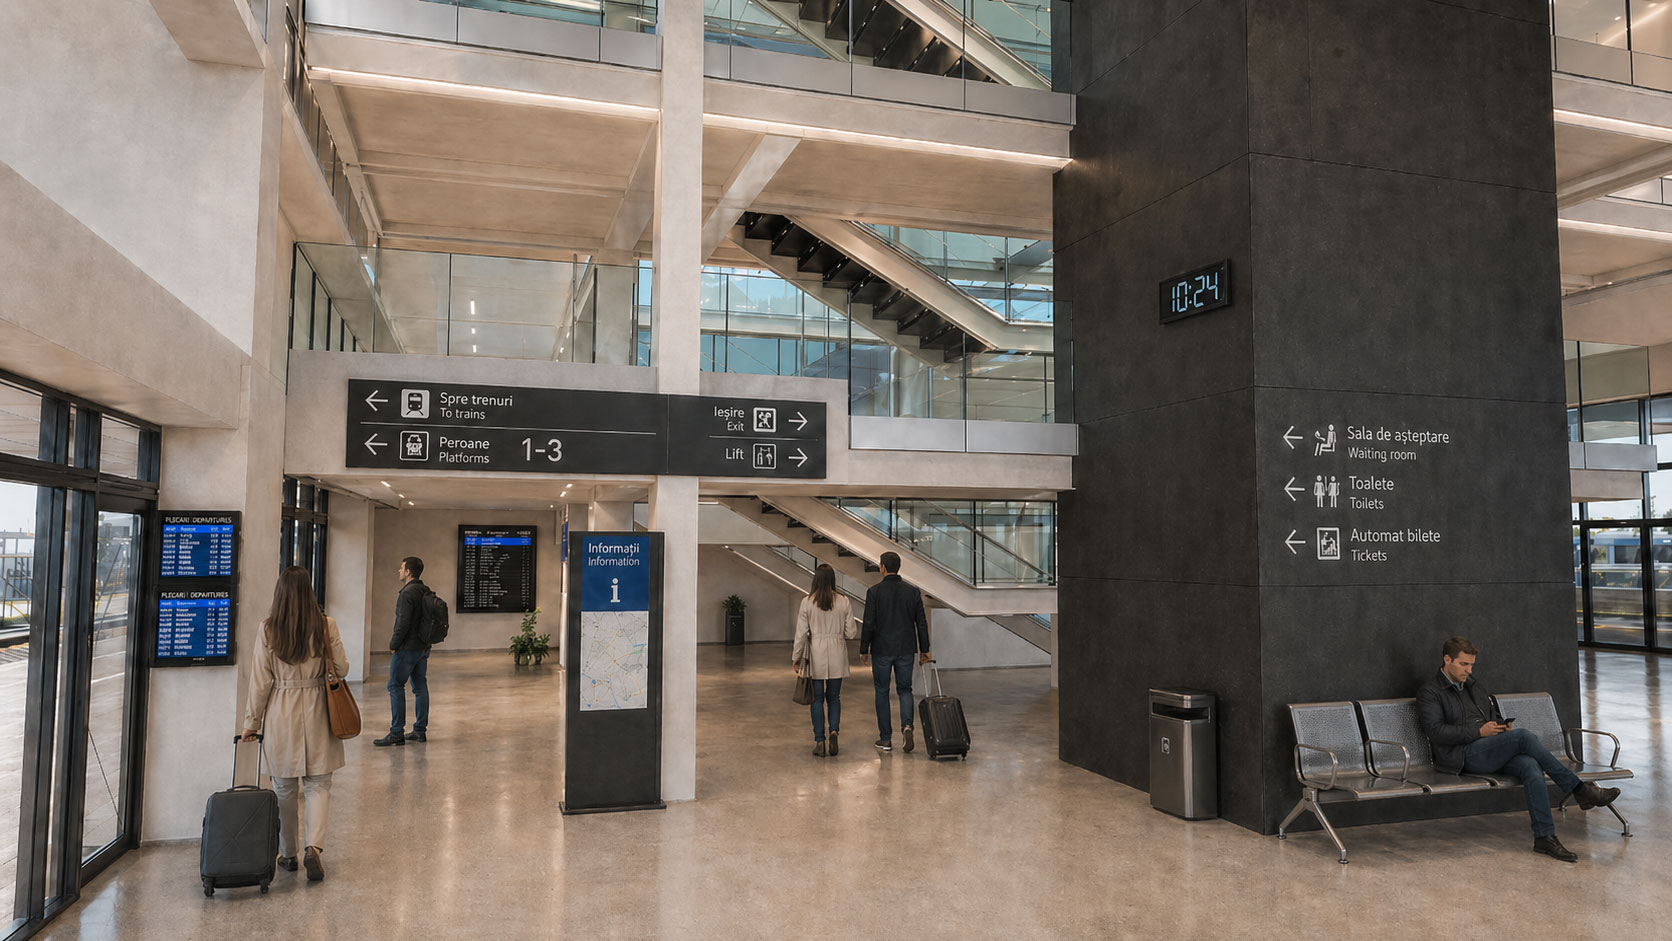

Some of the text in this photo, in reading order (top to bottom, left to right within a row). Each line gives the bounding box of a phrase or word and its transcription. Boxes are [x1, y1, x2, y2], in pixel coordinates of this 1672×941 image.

[1171, 271, 1219, 313] 10:24
[440, 391, 513, 407] Spre trenuri
[440, 407, 486, 420] To trains
[714, 406, 745, 421] Ieșire
[727, 421, 745, 432] Exit
[1347, 425, 1450, 446] Sala de așteptare
[440, 437, 563, 462] Peroane 1-3
[725, 447, 745, 460] Lift
[1347, 447, 1417, 463] Waiting room
[439, 451, 490, 464] Platforms
[1349, 475, 1395, 491] Toalete
[1350, 496, 1385, 510] Toilets
[1351, 528, 1441, 543] Automat bilete
[588, 542, 640, 557] Informații
[1351, 549, 1388, 562] Tickets
[588, 556, 640, 567] Information
[610, 578, 621, 603] i
